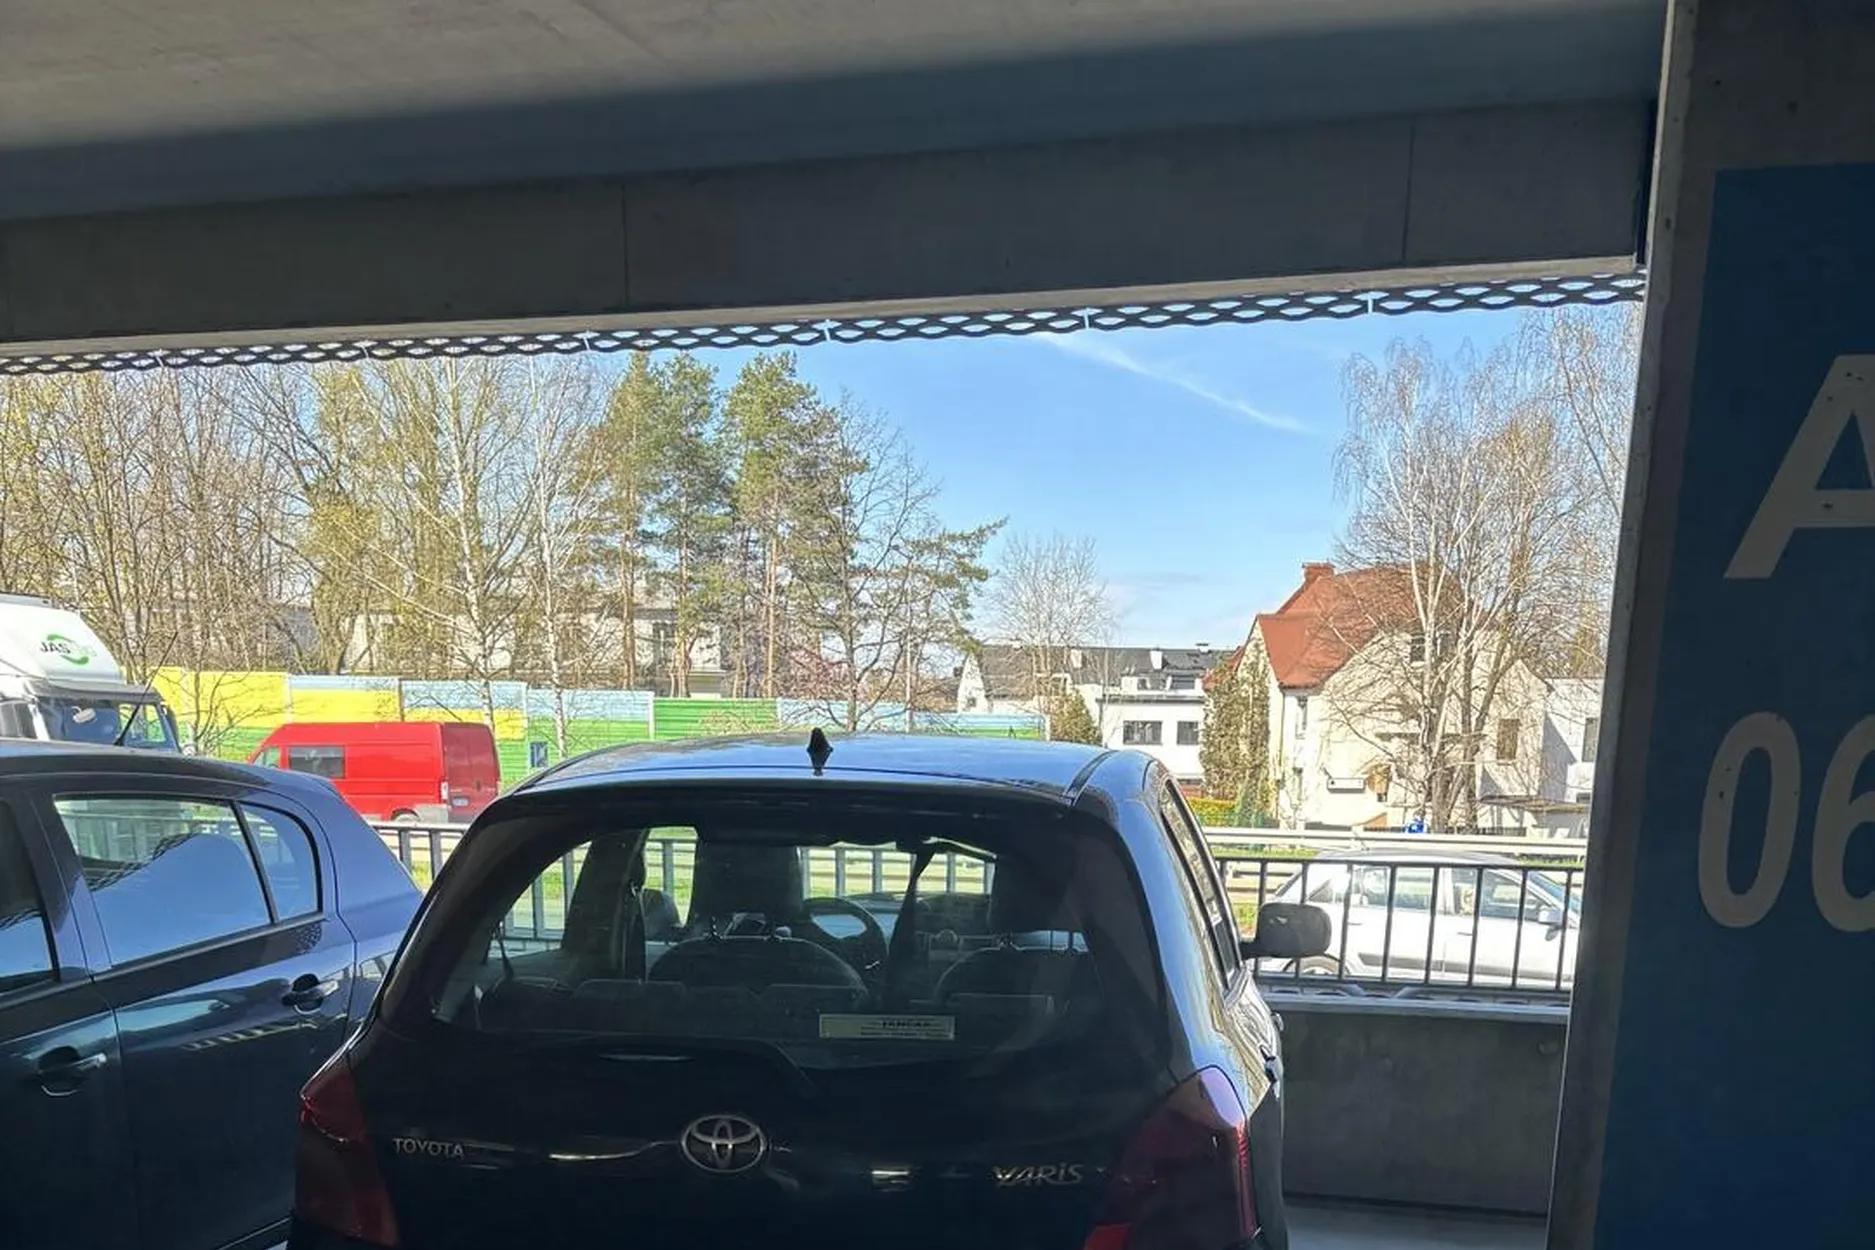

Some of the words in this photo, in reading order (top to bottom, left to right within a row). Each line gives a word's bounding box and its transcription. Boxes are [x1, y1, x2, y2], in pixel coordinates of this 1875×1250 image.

[1723, 354, 1875, 579] A
[1698, 711, 1875, 932] 06
[392, 1138, 464, 1159] TOYOTA
